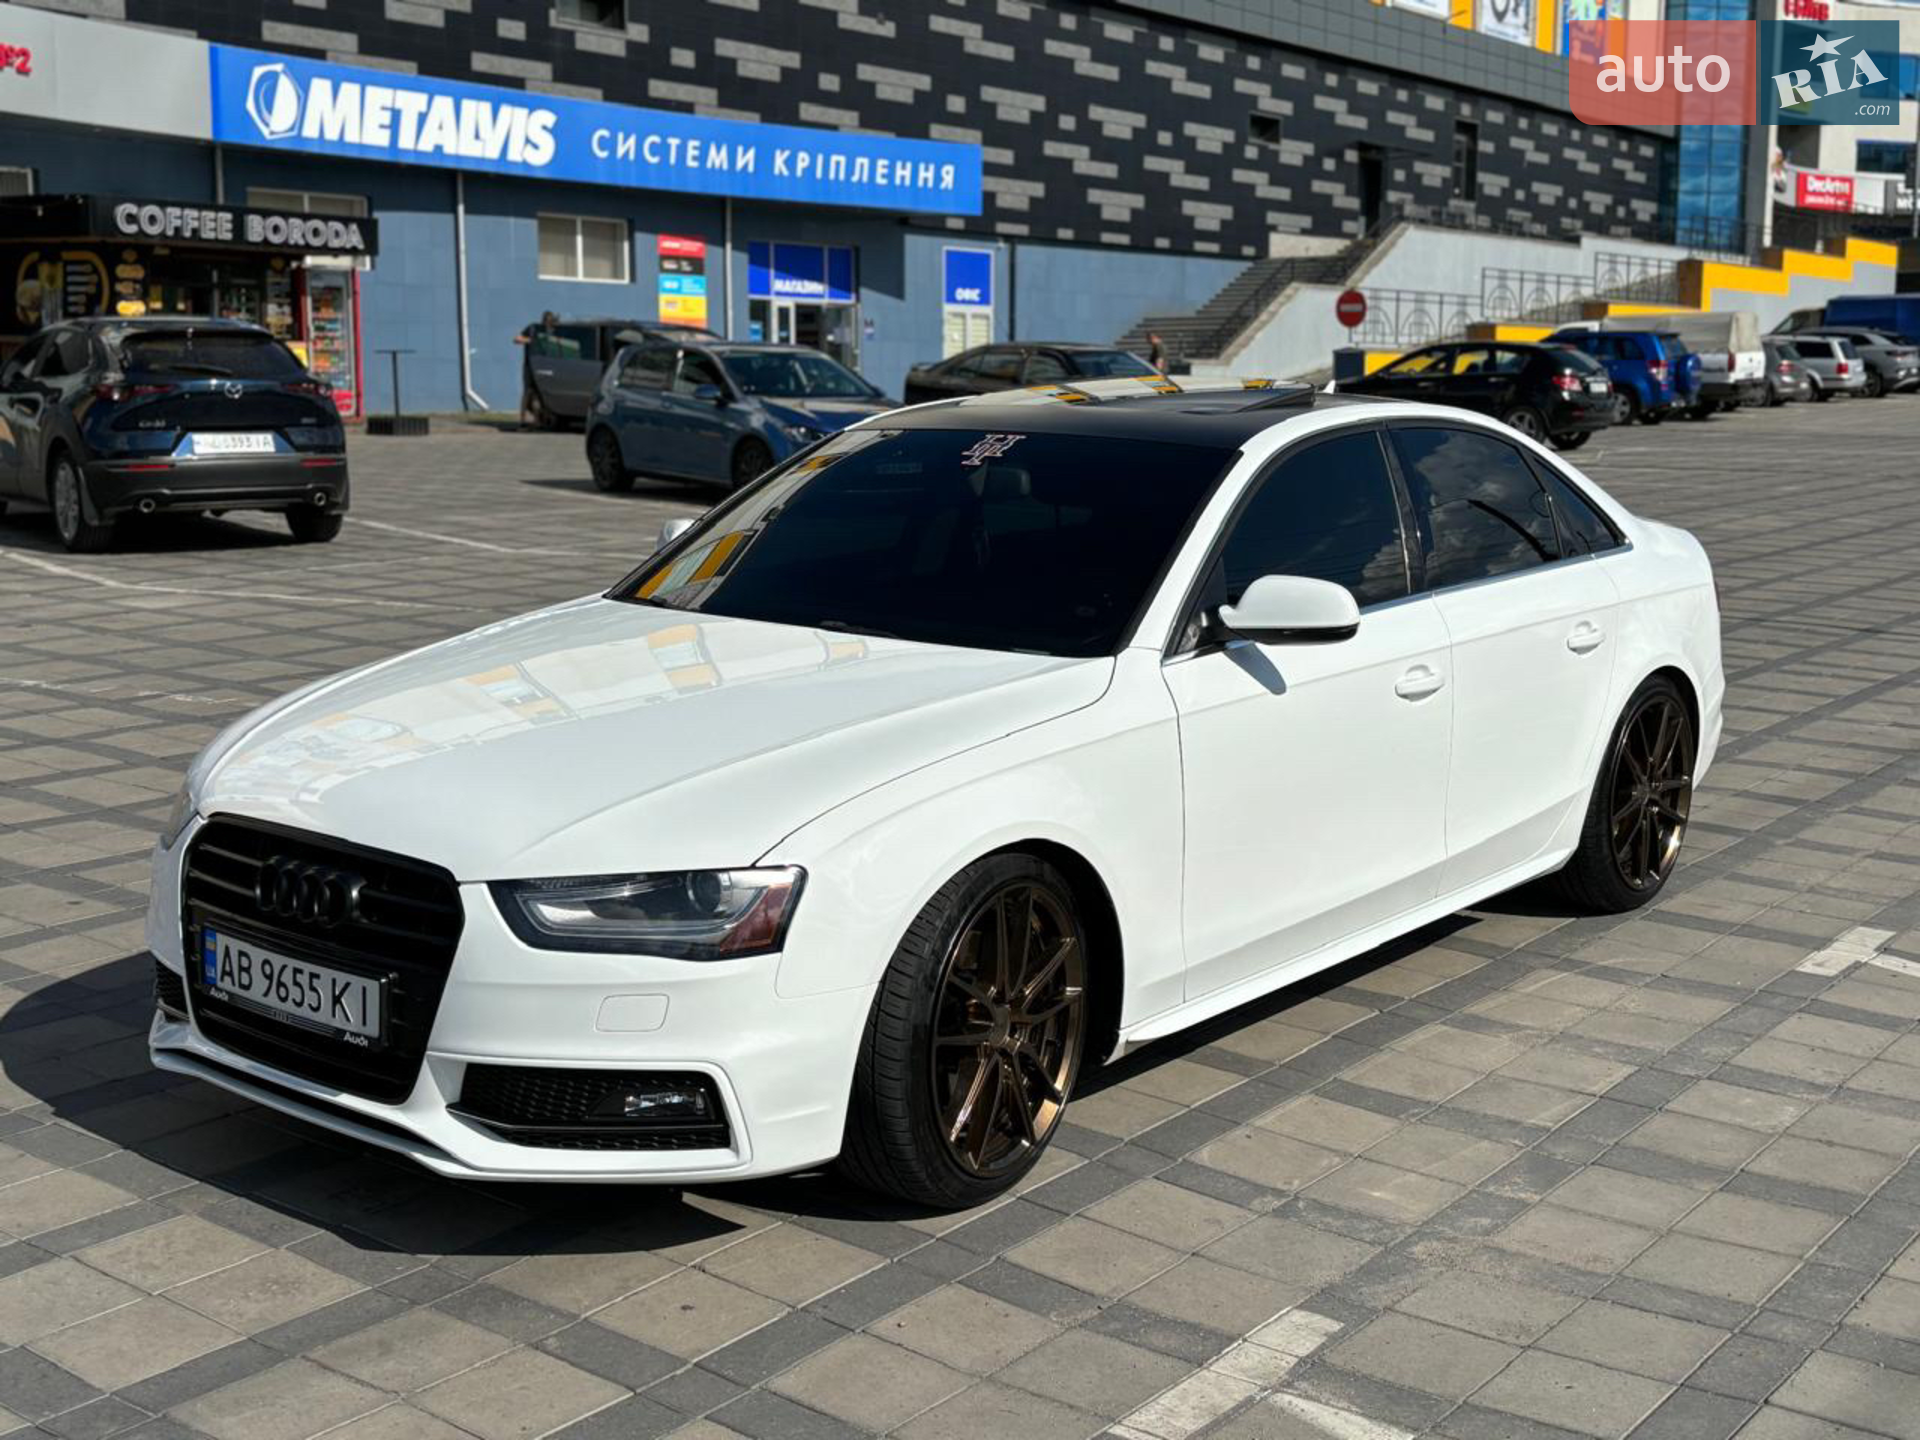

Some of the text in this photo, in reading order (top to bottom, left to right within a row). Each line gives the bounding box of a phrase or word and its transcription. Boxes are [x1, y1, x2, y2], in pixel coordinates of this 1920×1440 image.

[301, 76, 558, 167] METALVIS
[591, 128, 956, 190] СИСТЕМИ КРІПЛЕННЯ
[115, 202, 365, 250] COFFEE BORODA
[210, 986, 229, 1001] Audi
[220, 944, 367, 1028] AB 9655 KI
[343, 1031, 369, 1048] Audi
